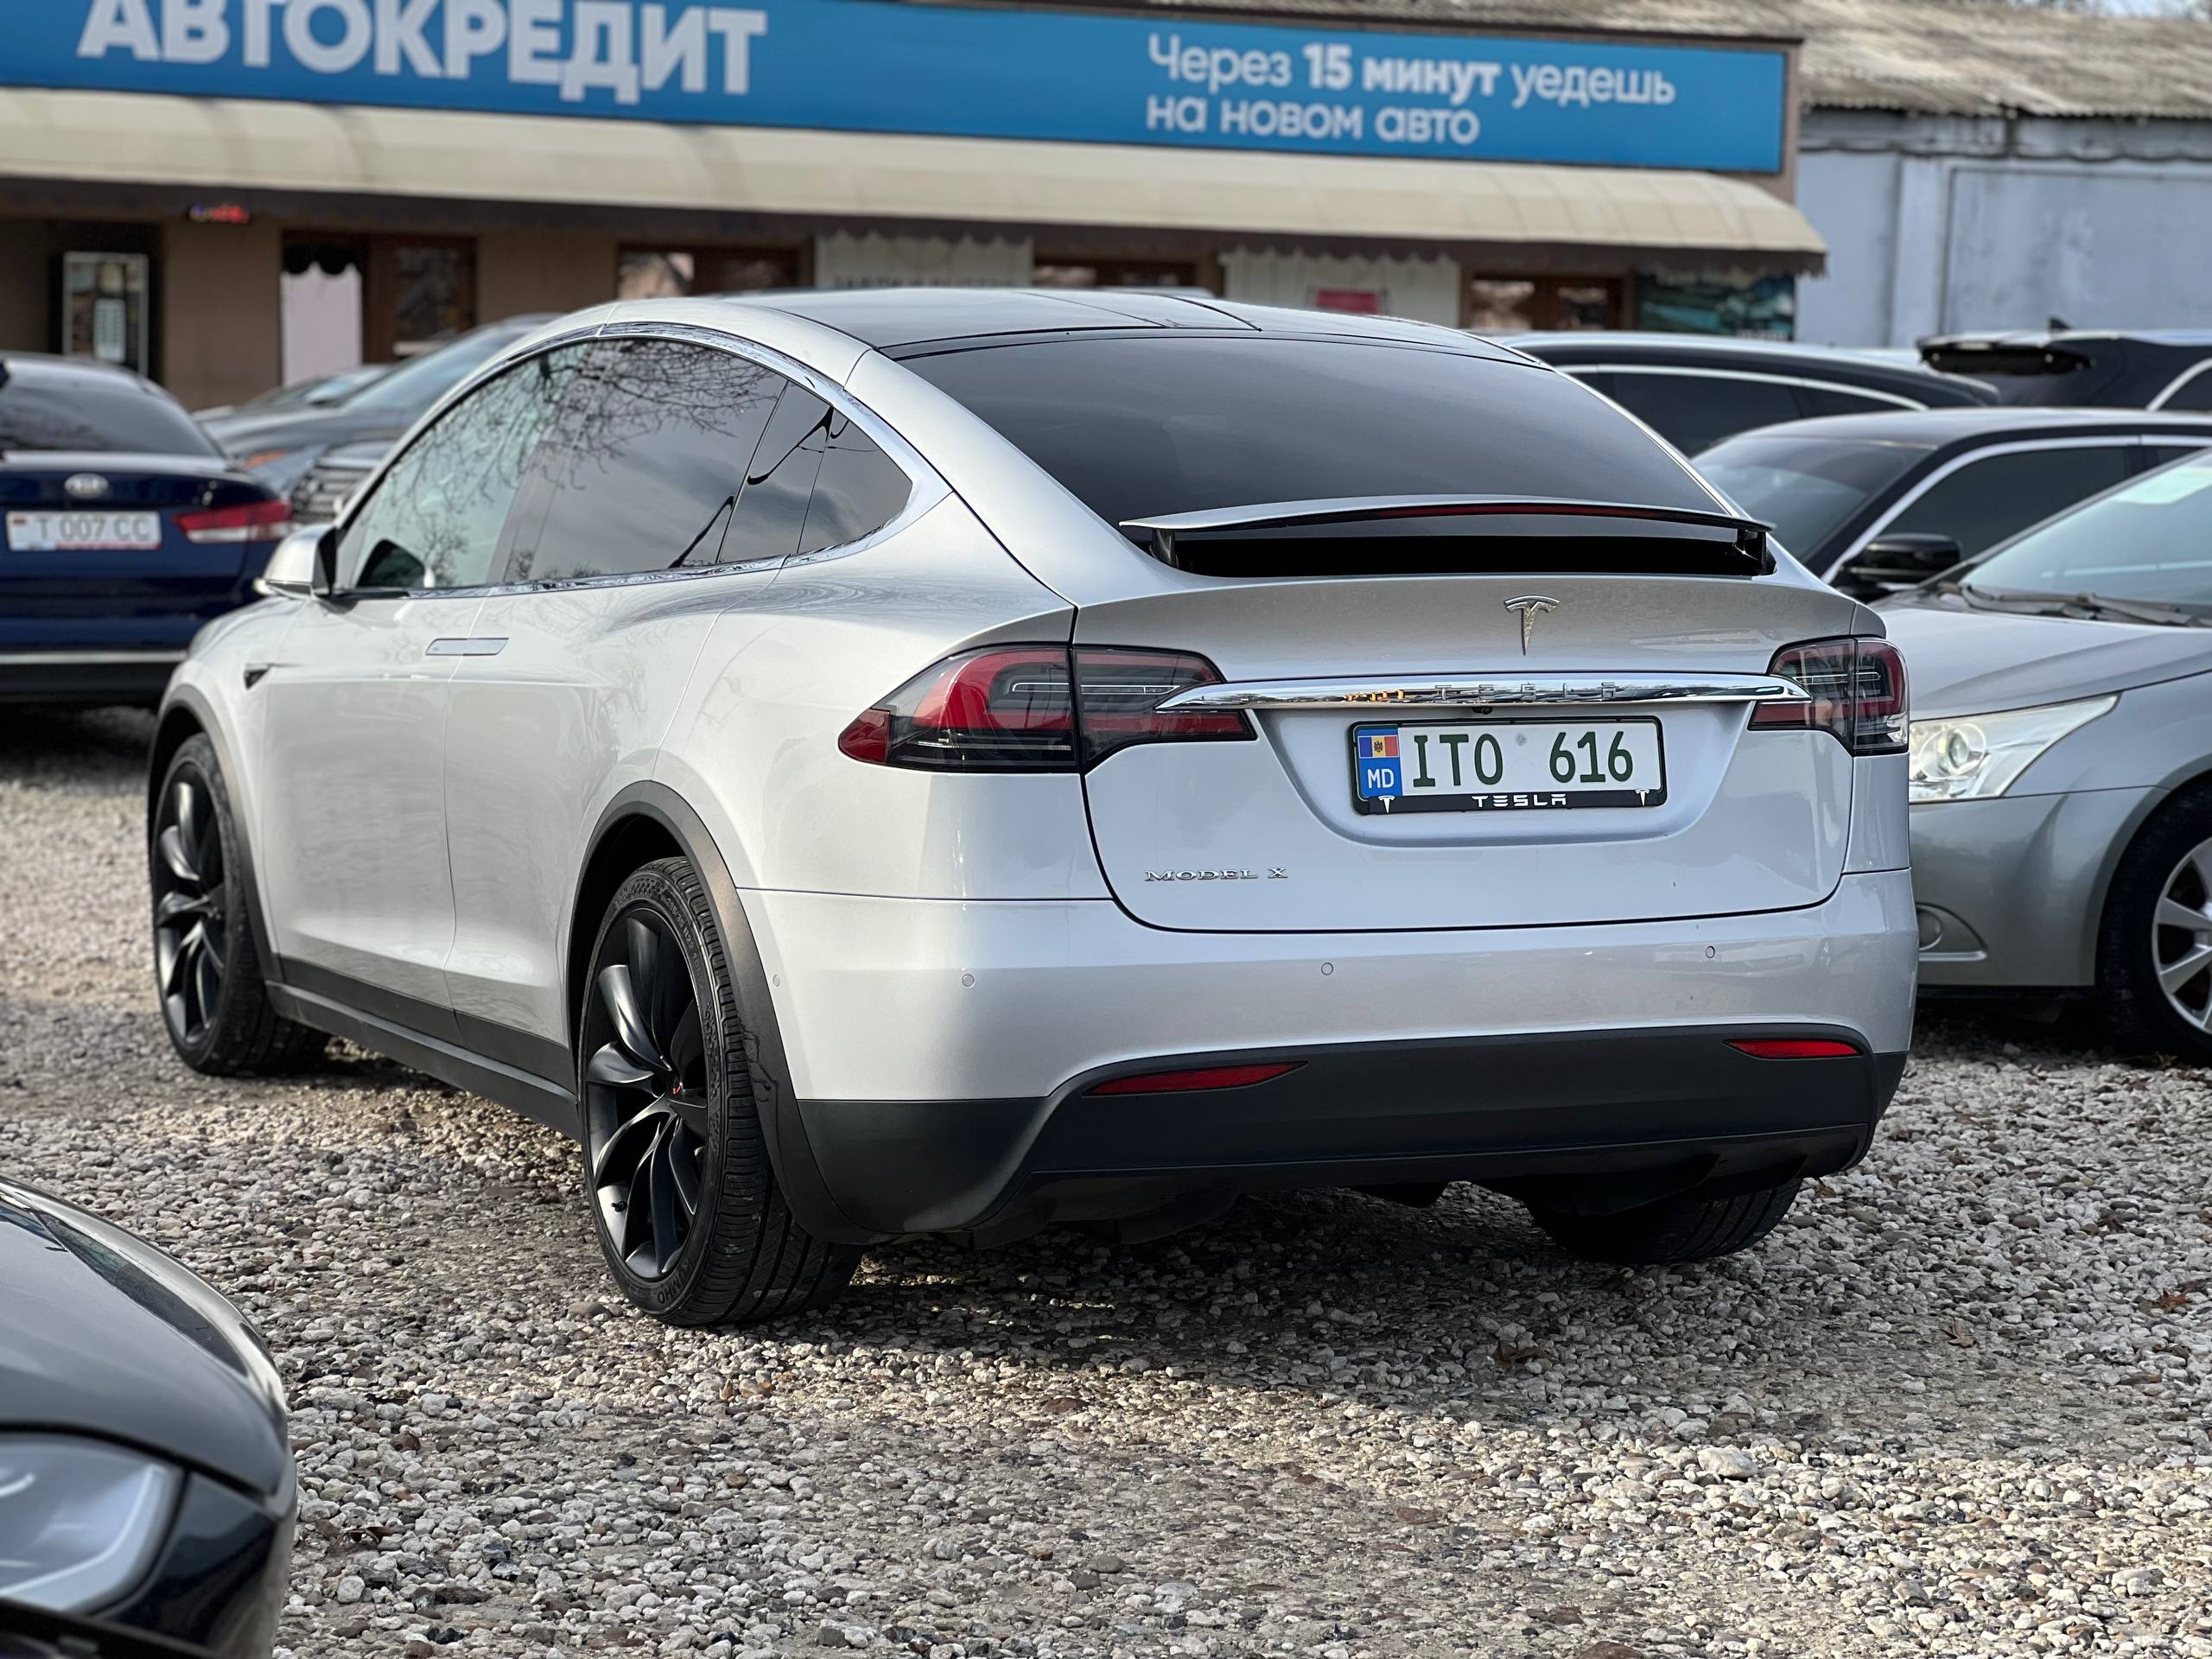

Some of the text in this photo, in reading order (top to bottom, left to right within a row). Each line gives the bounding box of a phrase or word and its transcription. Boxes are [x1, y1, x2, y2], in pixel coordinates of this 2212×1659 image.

[78, 0, 766, 103] АВТОКРЕДИТ
[1148, 33, 1676, 109] Через 15 минут уедешь
[1146, 95, 1480, 145] на новом авто
[59, 515, 106, 542] 007
[112, 515, 150, 542] CC
[1434, 681, 1617, 702] TESLA
[1549, 731, 1634, 783] 616
[1367, 768, 1395, 789] MD
[1471, 793, 1567, 808] TESLA
[1144, 867, 1289, 882] MODEL X
